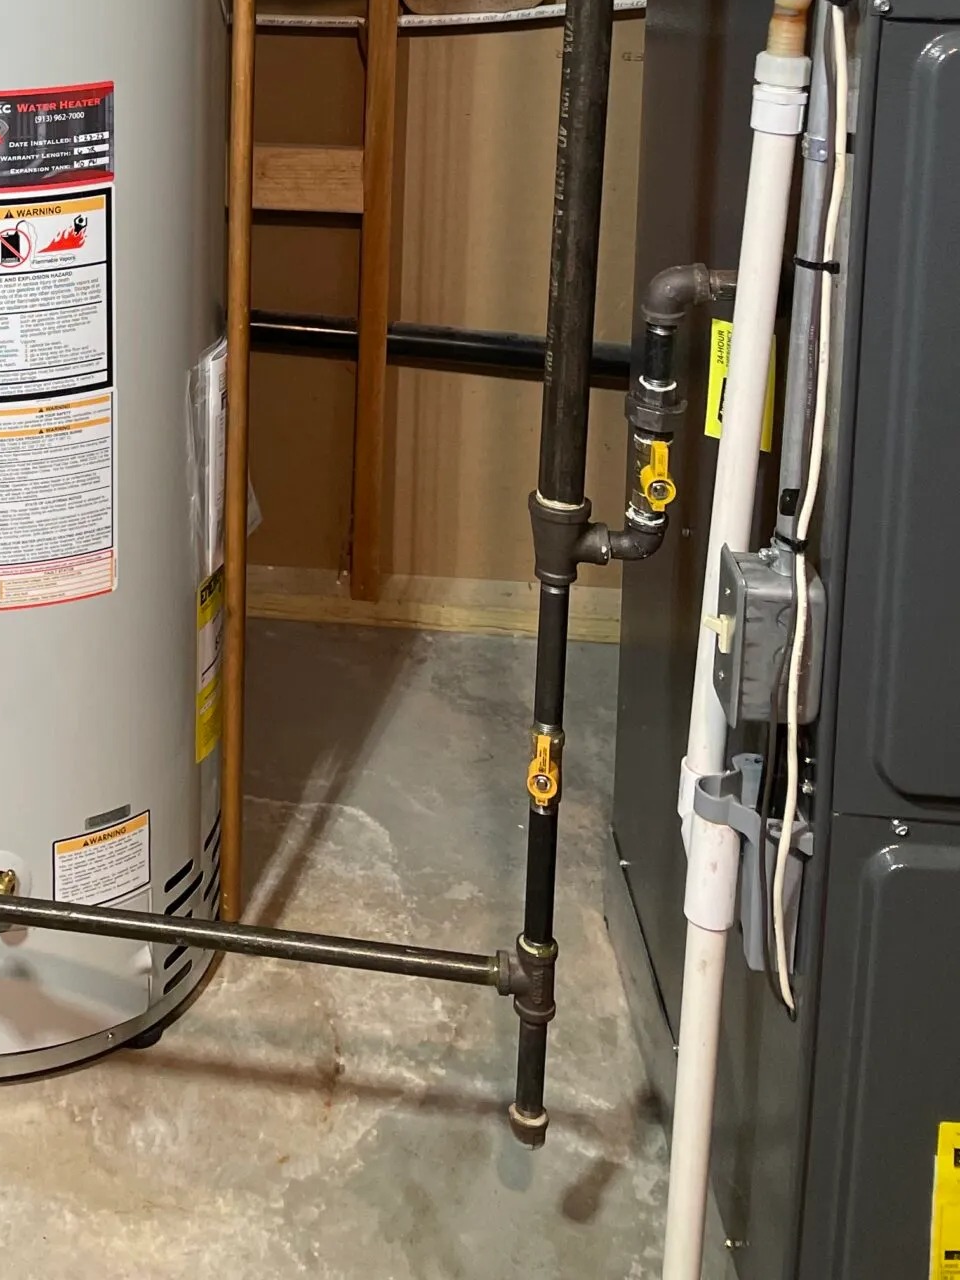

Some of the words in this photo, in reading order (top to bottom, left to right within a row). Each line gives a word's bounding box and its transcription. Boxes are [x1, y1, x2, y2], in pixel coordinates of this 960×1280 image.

[16, 102, 57, 113] WATER
[59, 97, 101, 110] HEATER
[34, 114, 52, 123] (913)
[53, 112, 85, 122] 962-7000
[8, 140, 29, 148] DATE
[30, 137, 72, 147] INSTALLED:
[0, 154, 39, 162] WARRANTY
[41, 151, 71, 160] LENGTH:
[10, 166, 50, 175] EXPANSION
[51, 164, 71, 172] TANK:
[16, 206, 62, 218] WARNING
[32, 257, 58, 265] Flammable
[18, 273, 50, 282] EXPLOSION
[716, 330, 725, 365] 24-HOUR
[46, 403, 70, 411] WARNING
[46, 425, 70, 433] WARNING
[89, 827, 127, 846] WARNING
